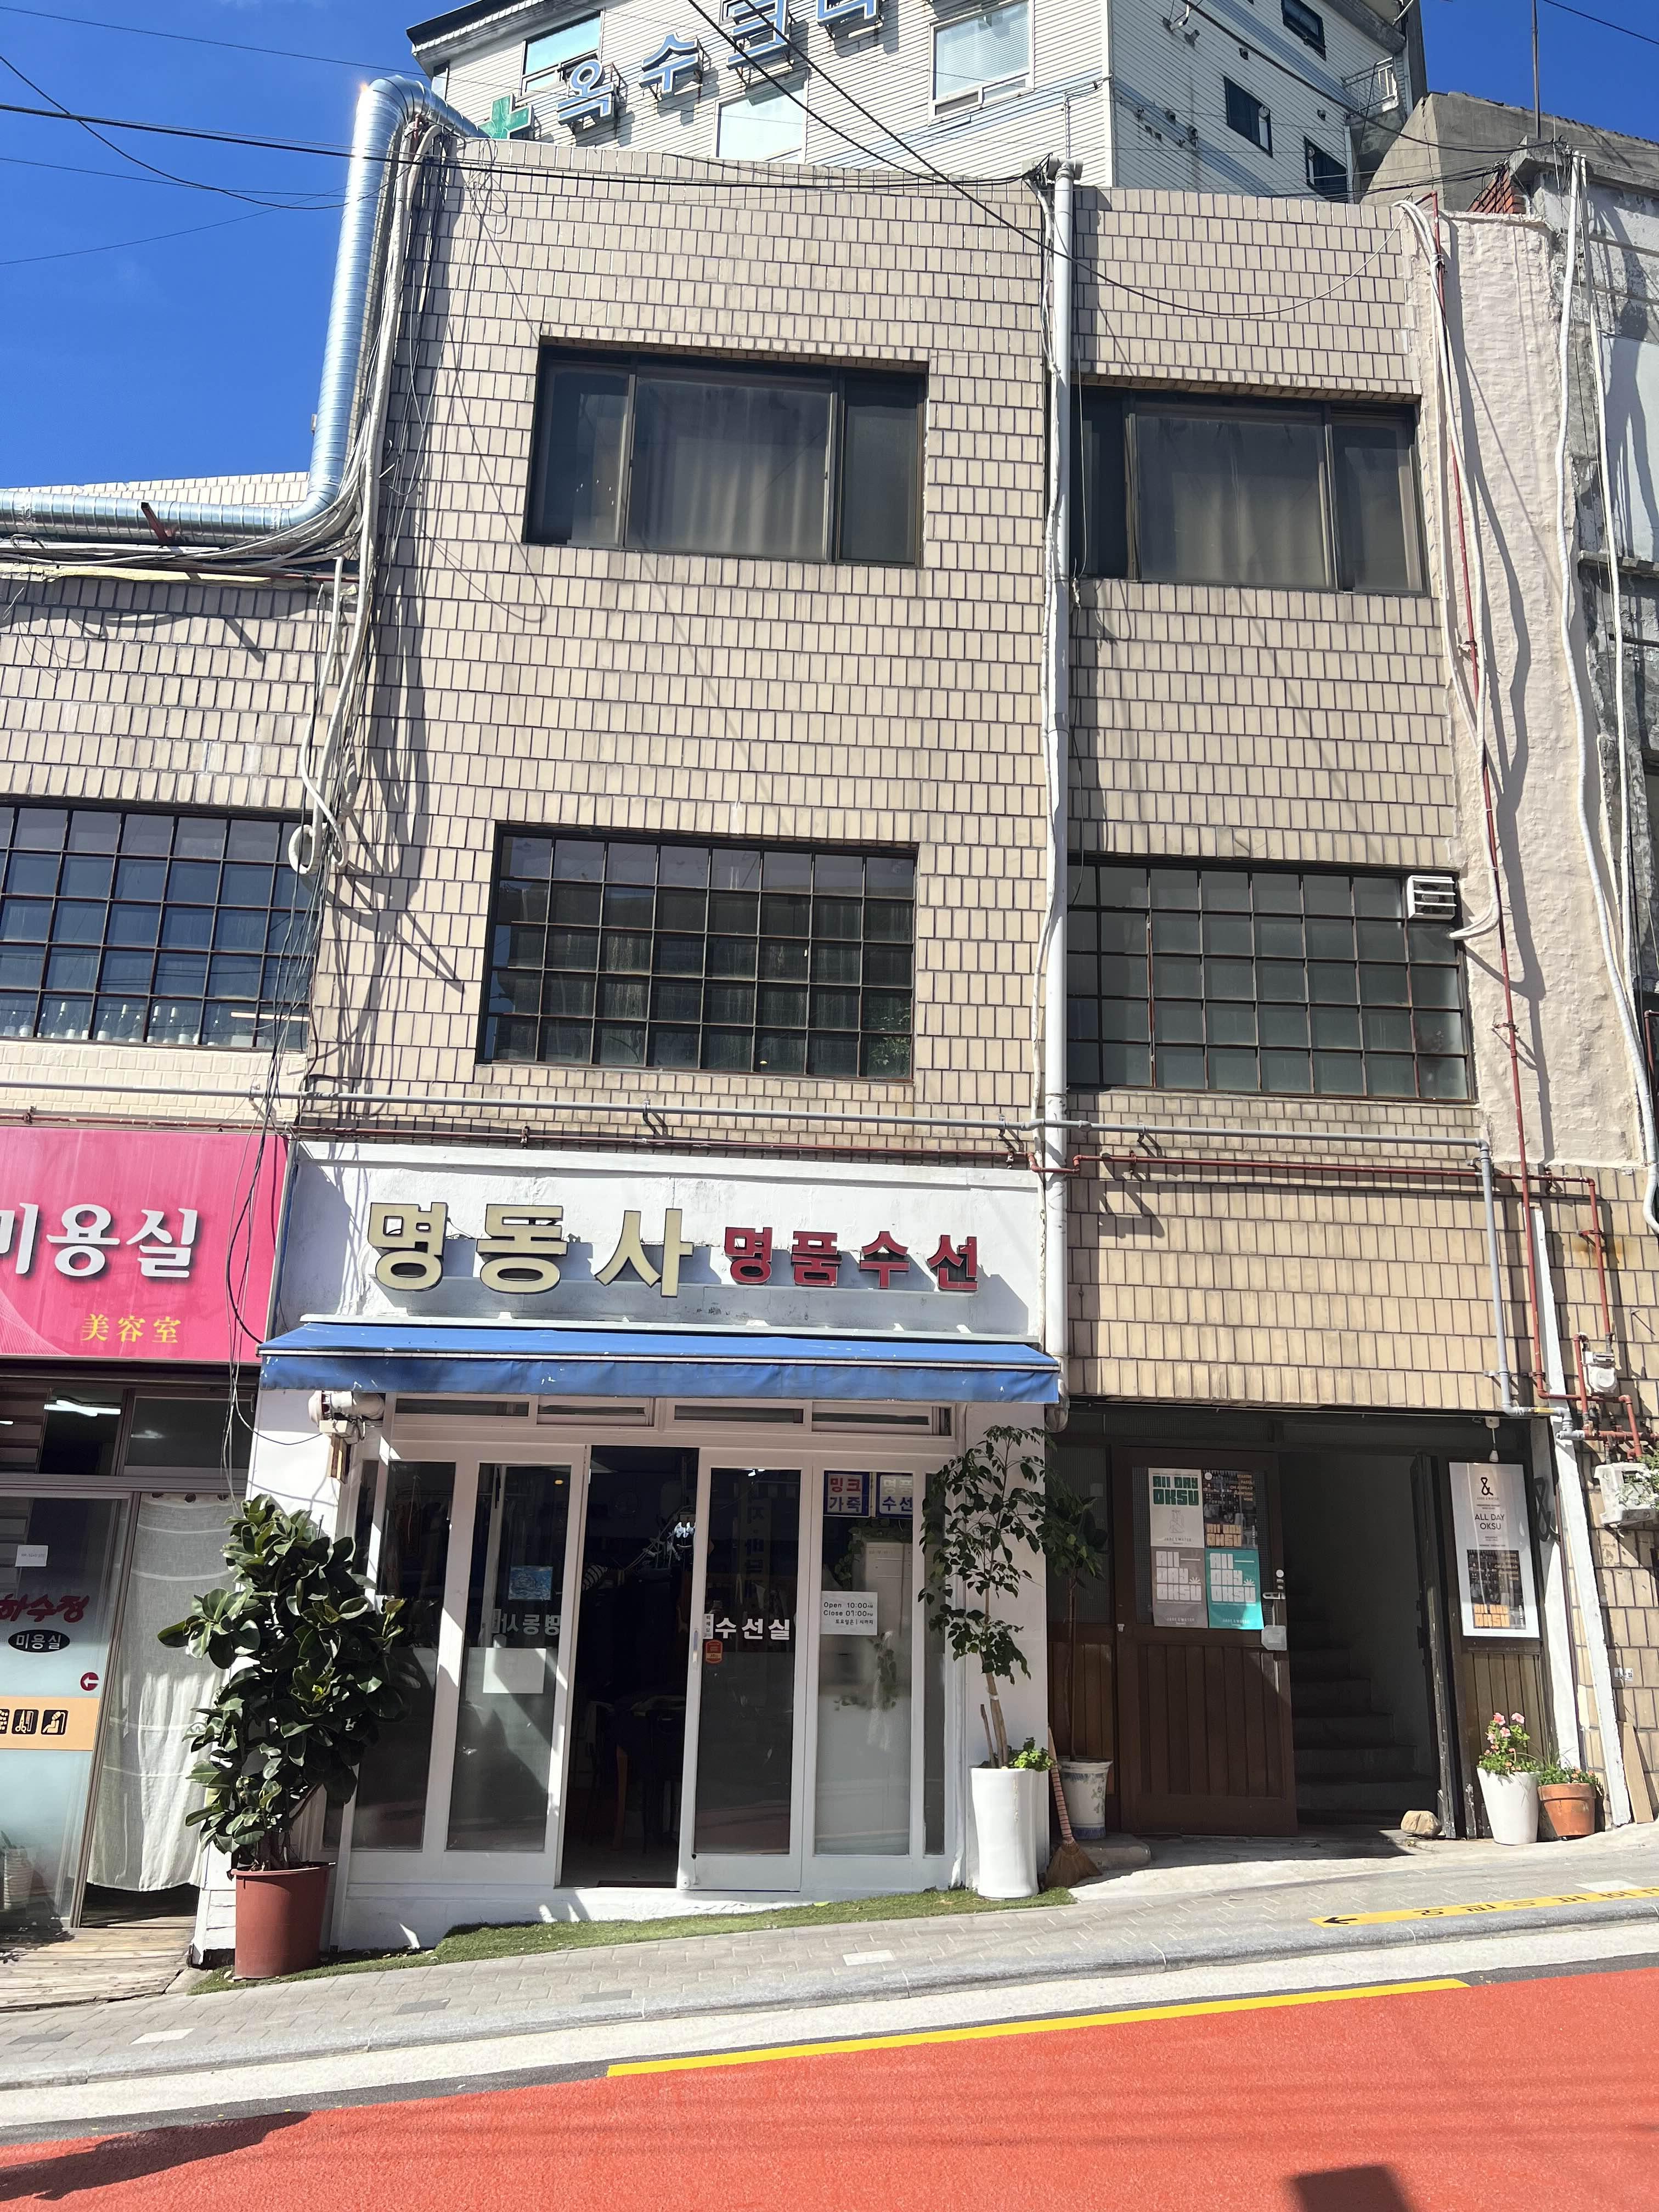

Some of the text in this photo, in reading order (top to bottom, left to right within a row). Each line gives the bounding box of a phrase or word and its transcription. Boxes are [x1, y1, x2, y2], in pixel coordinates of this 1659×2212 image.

[0, 1203, 198, 1278] 미용실
[367, 1202, 979, 1298] 명동사 명품수선
[80, 1313, 181, 1344] 美容室
[830, 1477, 861, 1493] 밍크
[829, 1496, 861, 1513] 가죽
[882, 1496, 913, 1512] 수선
[1153, 1489, 1199, 1506] OKSU
[715, 1617, 790, 1640] 수선실
[15, 1633, 61, 1650] 미용실
